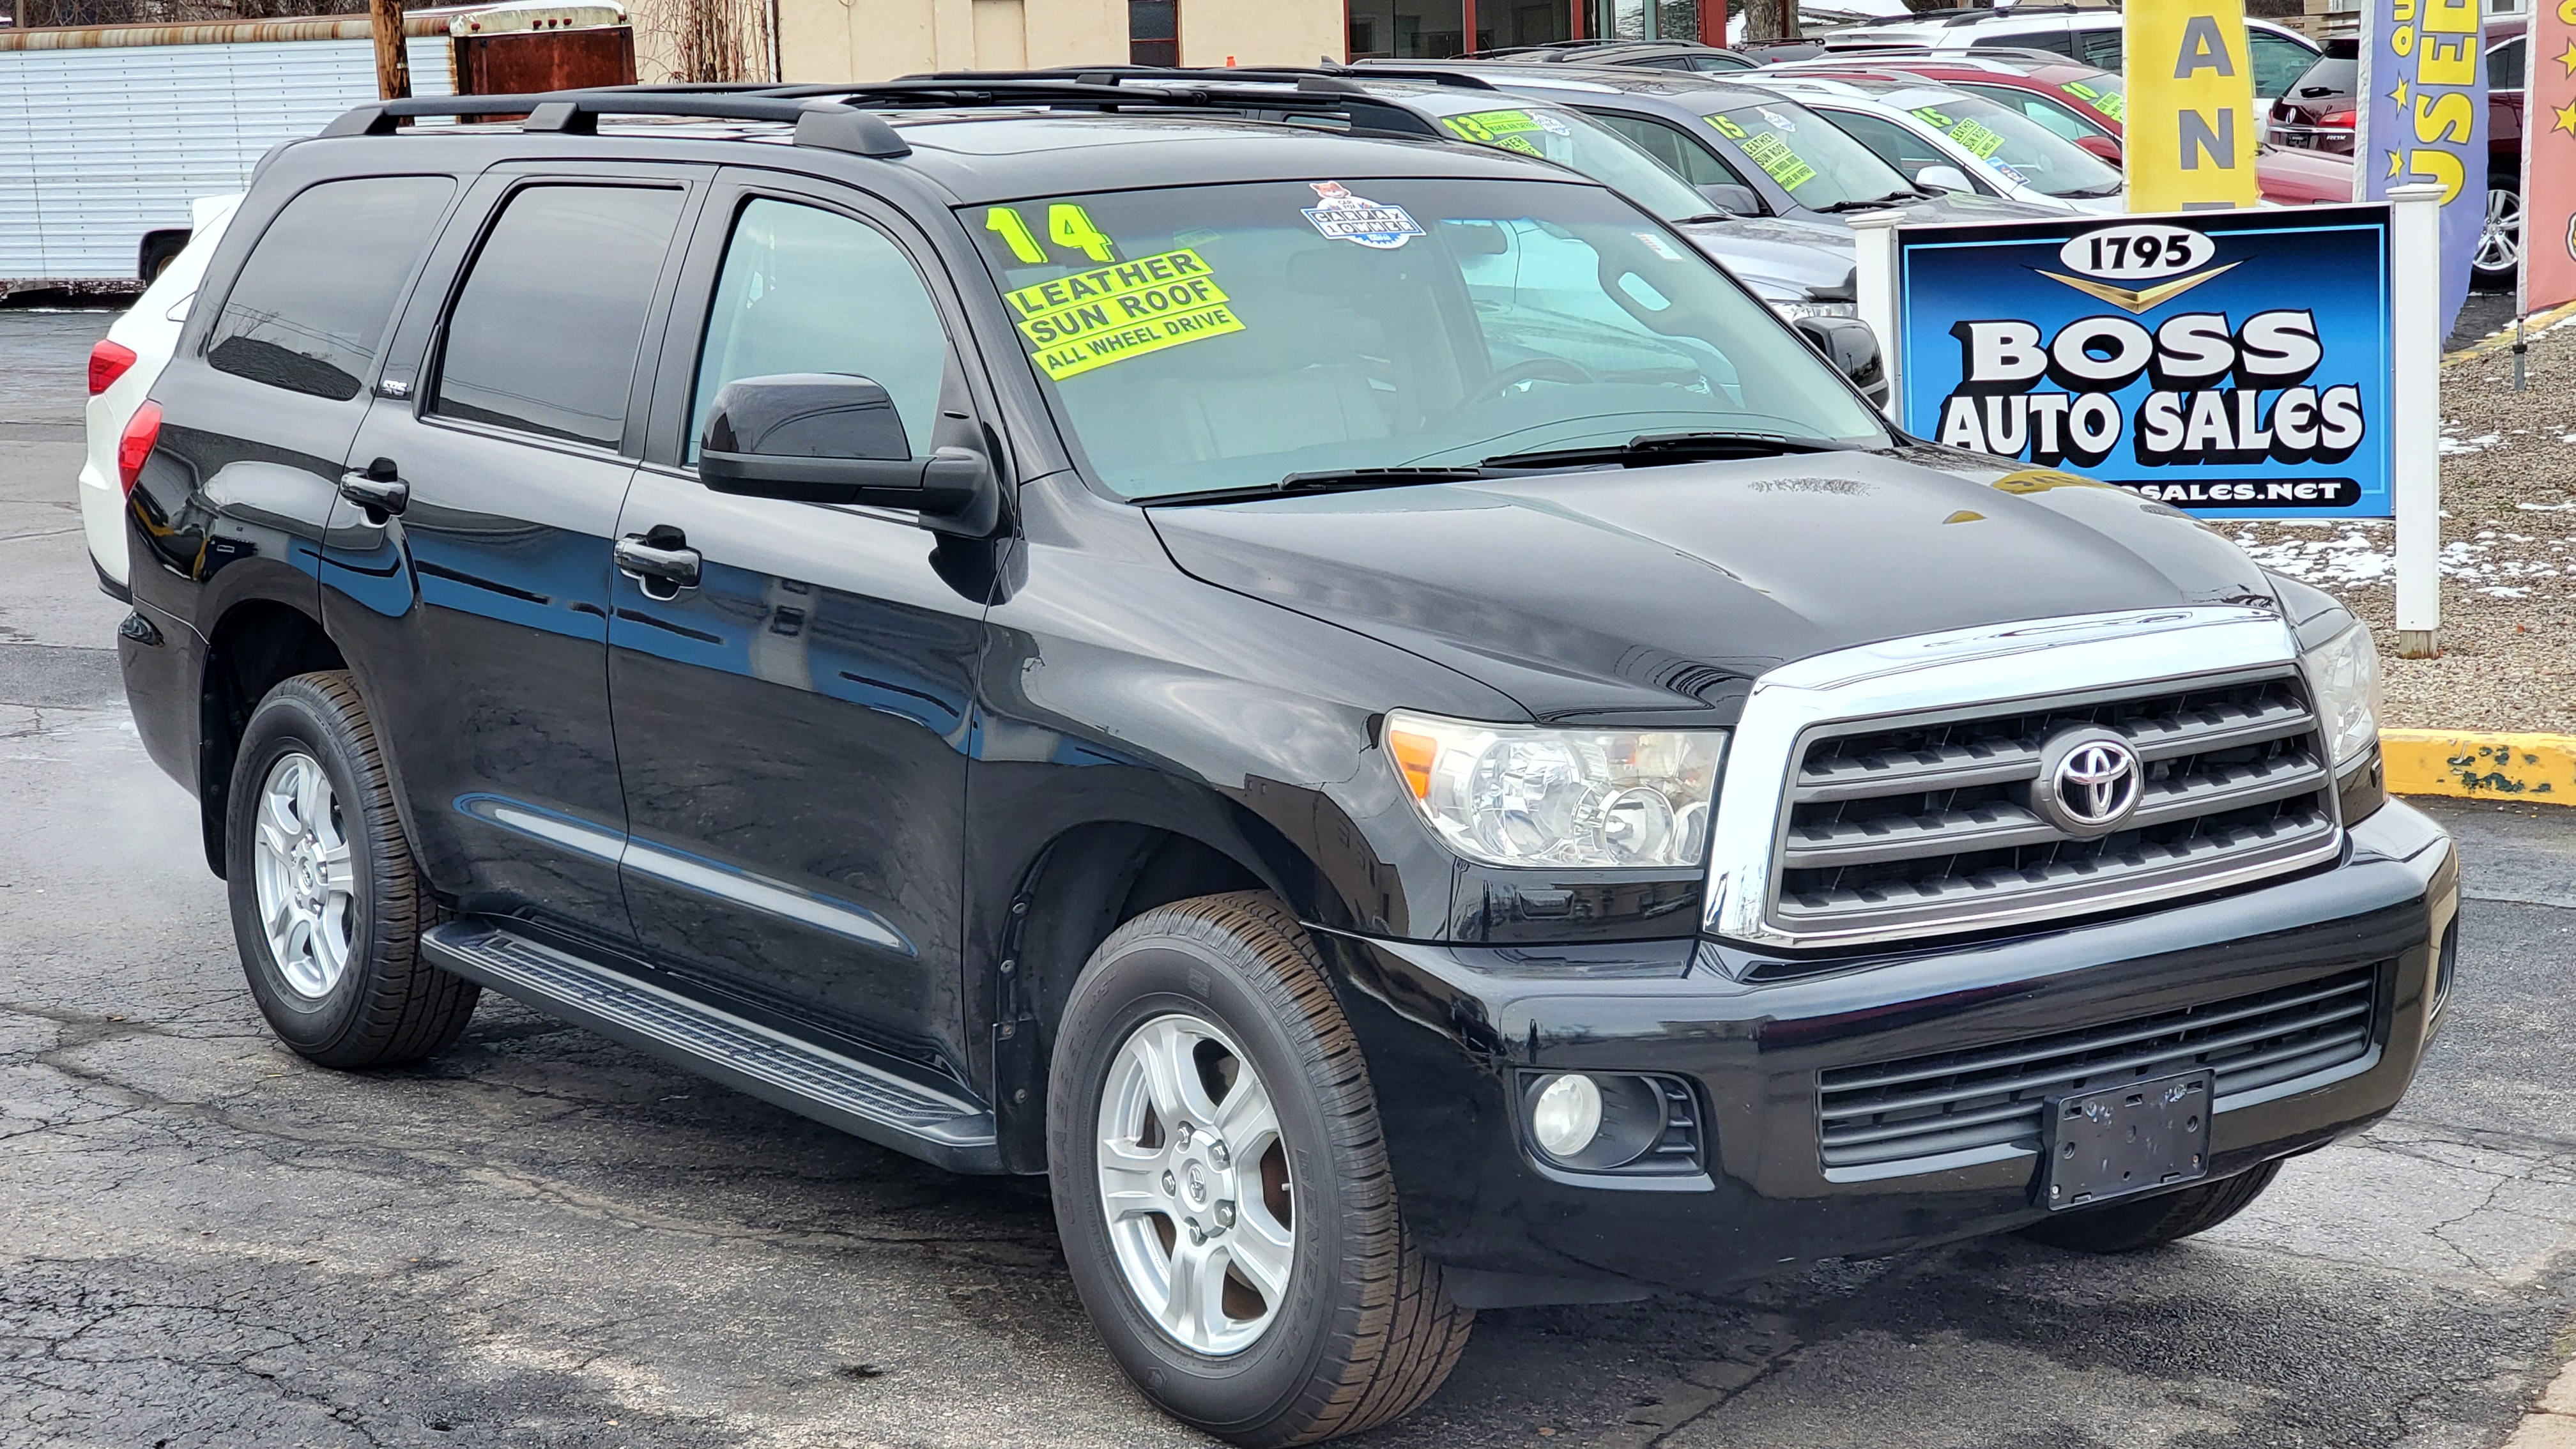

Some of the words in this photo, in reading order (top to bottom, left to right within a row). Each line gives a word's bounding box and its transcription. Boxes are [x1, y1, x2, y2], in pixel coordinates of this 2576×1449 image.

[1442, 116, 1494, 141] 13
[1703, 115, 1747, 139] 15
[1912, 107, 1952, 127] 15
[2174, 15, 2235, 211] AN
[1742, 133, 1776, 155] LEATHER
[1755, 151, 1773, 165] SUN
[1768, 143, 1788, 157] ROOF
[986, 204, 1113, 263] 14
[1313, 211, 1404, 222] CARFAX
[1327, 224, 1336, 233] 1
[1340, 221, 1417, 233] OWNER
[2089, 234, 2192, 272] 1795
[1016, 252, 1201, 314] LEATHER
[1030, 304, 1110, 344] SUN
[1117, 279, 1211, 319] ROOF
[1046, 347, 1087, 371] ALL
[1087, 326, 1162, 356] WHEEL
[1163, 309, 1230, 336] DRIVE
[1958, 310, 2322, 383] BOSS
[1942, 392, 2122, 455] AUTO
[2144, 385, 2363, 451] SALES
